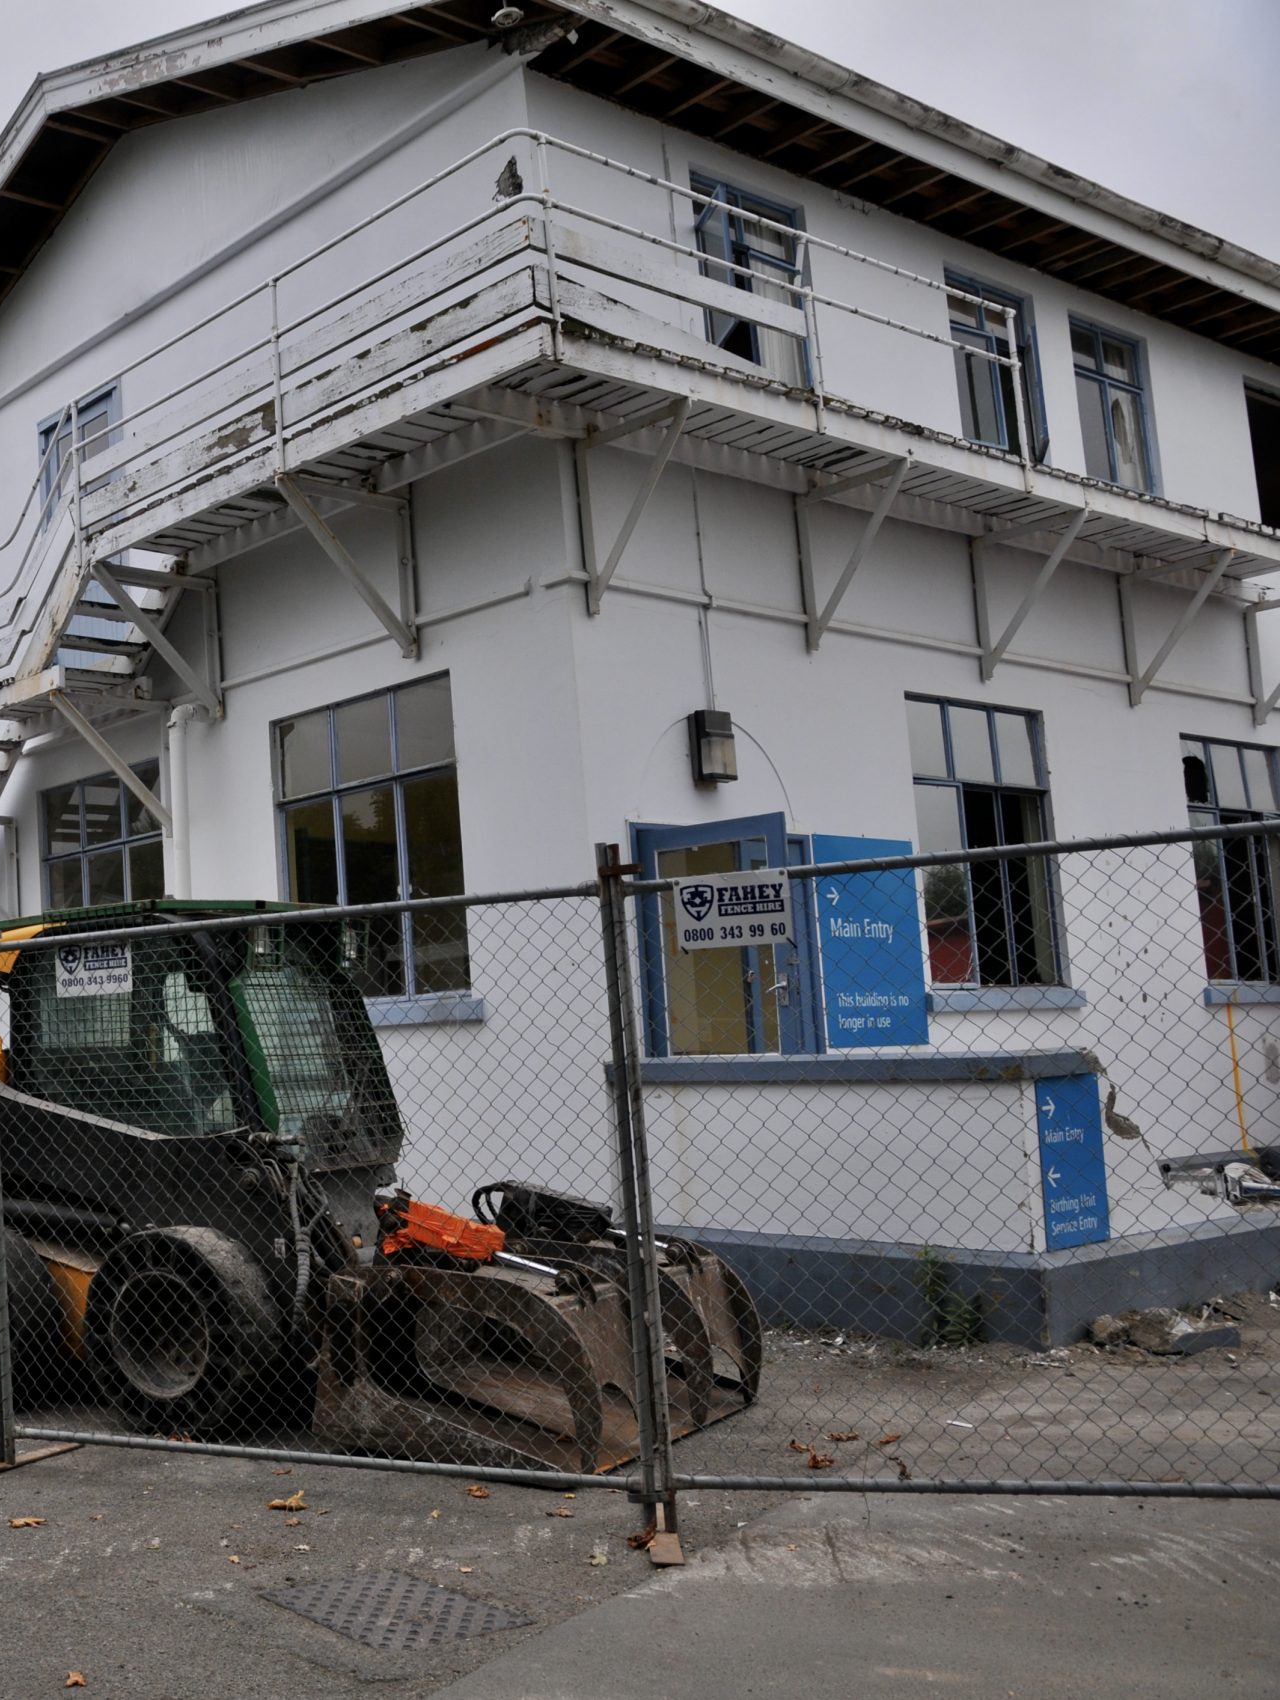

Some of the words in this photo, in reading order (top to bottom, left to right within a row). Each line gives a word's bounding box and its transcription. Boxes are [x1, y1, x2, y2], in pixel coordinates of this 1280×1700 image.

[716, 883, 783, 903] FAHEY
[721, 903, 754, 915] FENCE
[756, 902, 782, 911] HIRE
[684, 927, 714, 942] 0800
[720, 925, 743, 940] 343
[749, 923, 764, 938] 99
[770, 922, 786, 936] 60
[830, 917, 862, 938] Main
[863, 918, 894, 944] Entry
[83, 945, 126, 958] FAHEY
[85, 961, 108, 969] FENCE
[61, 977, 84, 988] 0800
[86, 975, 104, 986] 343
[106, 973, 128, 984] 9960
[837, 994, 853, 1007] This
[855, 992, 889, 1010] building
[890, 993, 897, 1005] is
[898, 996, 910, 1006] no
[838, 1014, 865, 1032] longer
[866, 1015, 875, 1028] in
[876, 1017, 891, 1028] use
[1044, 1130, 1065, 1144] Main
[1065, 1127, 1084, 1143] Entry
[1050, 1197, 1079, 1214] Birthing
[1080, 1193, 1096, 1208] Unit
[1052, 1220, 1078, 1236] Service
[1079, 1215, 1098, 1231] Entry
